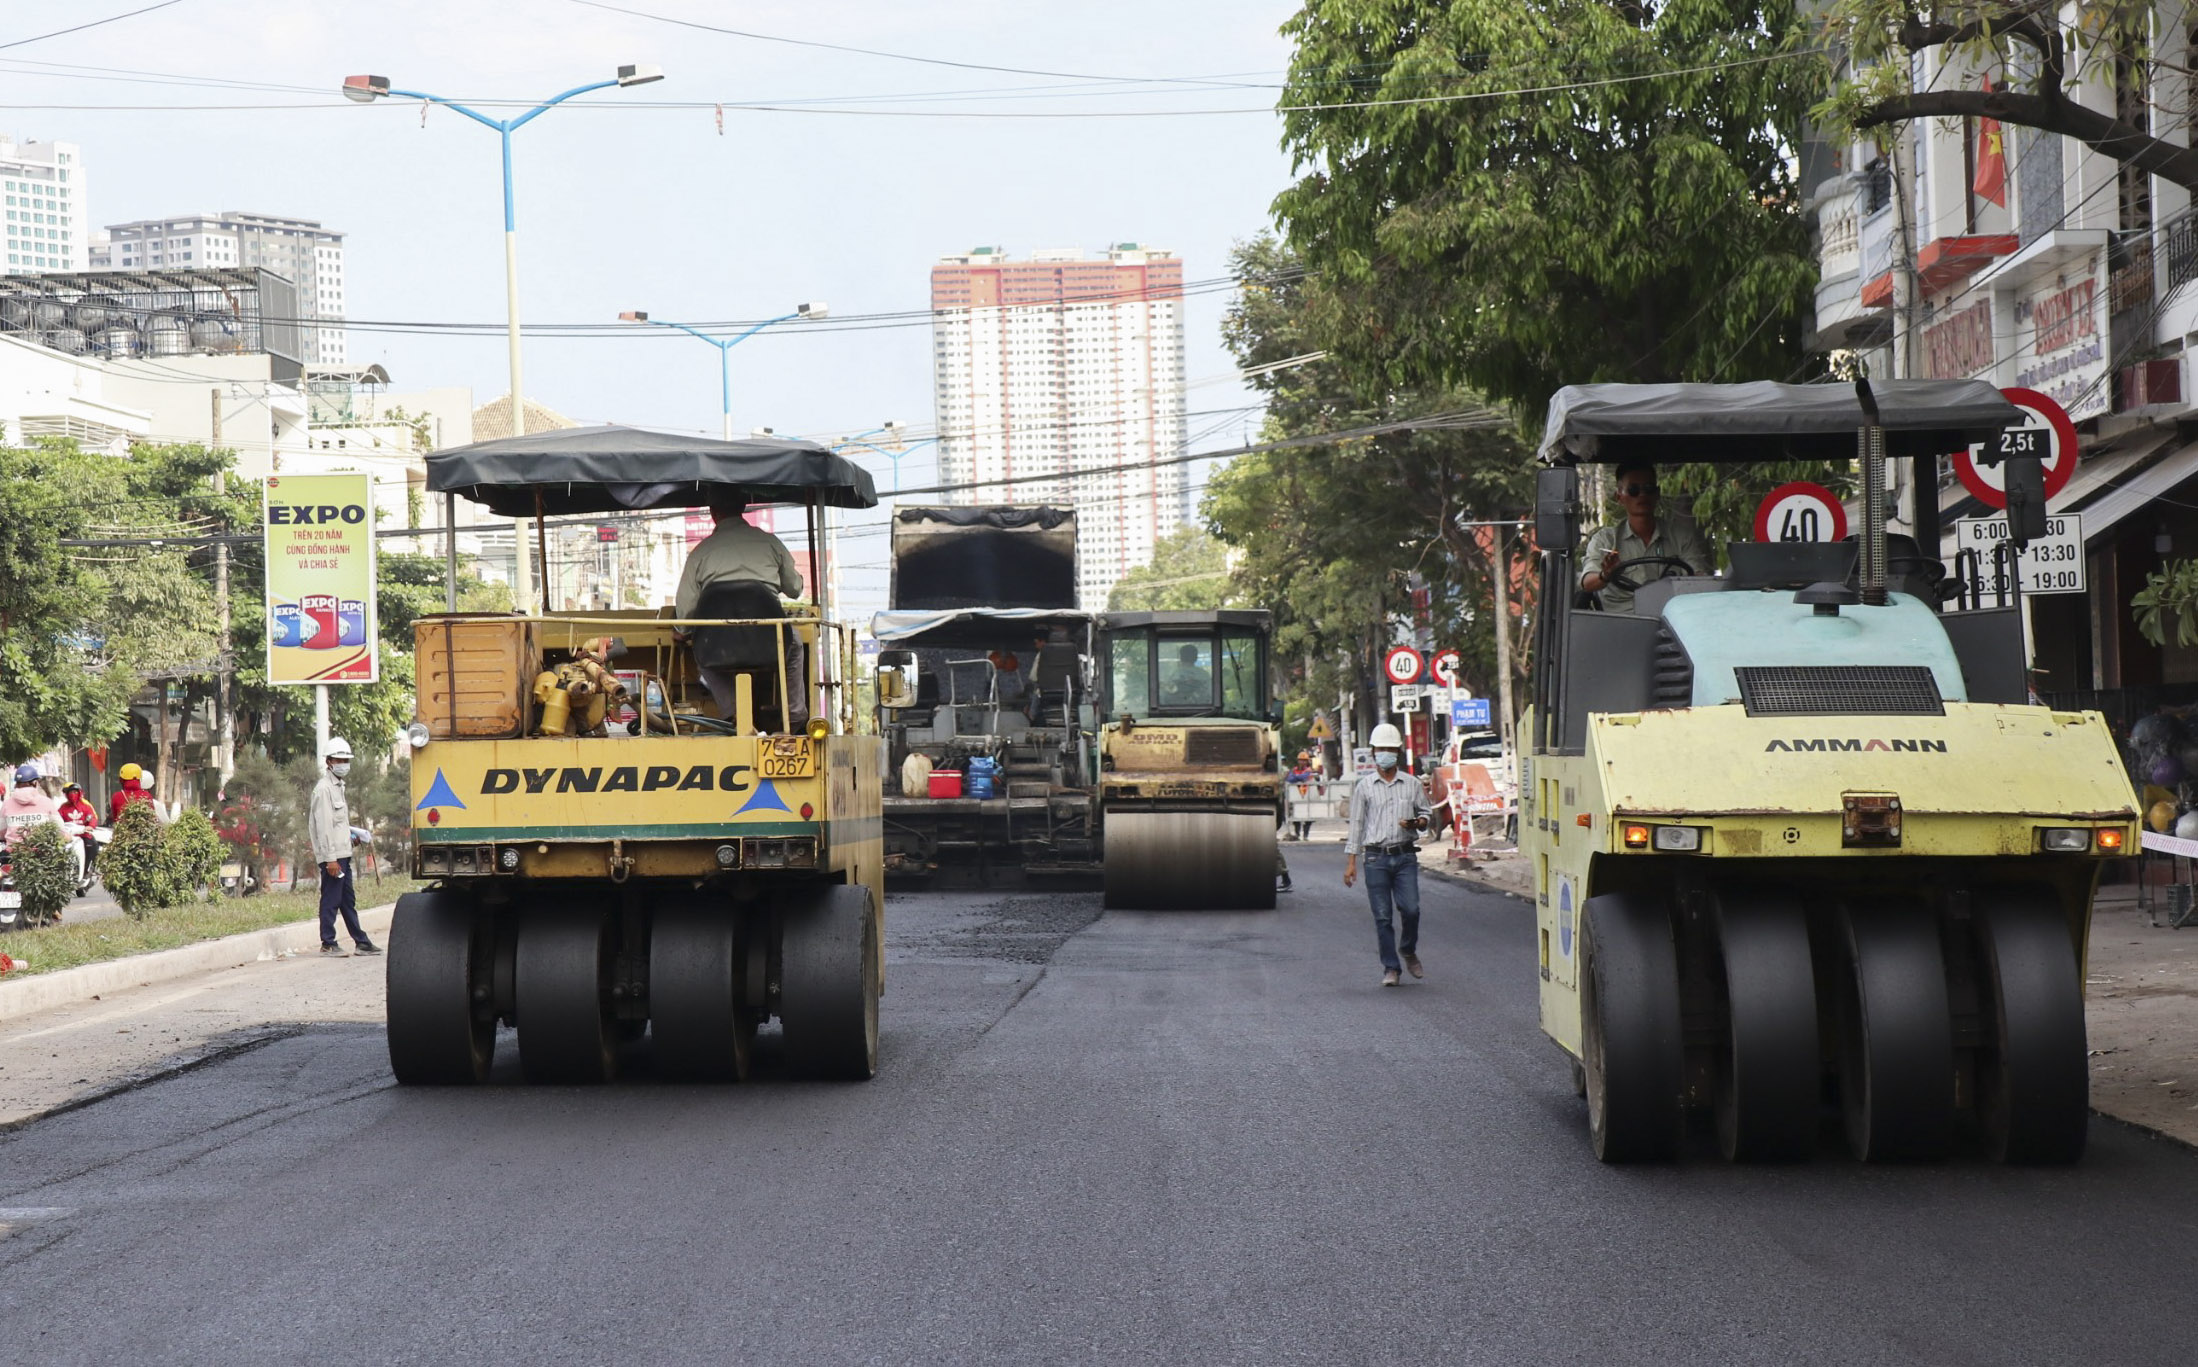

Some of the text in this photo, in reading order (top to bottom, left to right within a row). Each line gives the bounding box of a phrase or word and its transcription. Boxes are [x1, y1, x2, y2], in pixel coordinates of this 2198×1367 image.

[2000, 433, 2034, 455] 2,5t
[268, 504, 366, 525] EXPO
[1780, 507, 1819, 542] 40
[1973, 522, 2008, 540] 6:00
[293, 529, 343, 540] TRÊN 20 NĂM
[286, 543, 350, 555] CÙNG ĐỒNG HÀNH
[2031, 544, 2076, 562] 13:30
[298, 558, 308, 569] VÀ
[310, 559, 328, 569] CHIA
[2033, 571, 2077, 589] 19:00
[302, 597, 336, 609] EXPO
[339, 602, 364, 612] EXPO
[1395, 657, 1411, 673] 40
[1764, 738, 1948, 753] AMMANN
[764, 758, 808, 775] 0267
[480, 764, 751, 794] DYNAPAC
